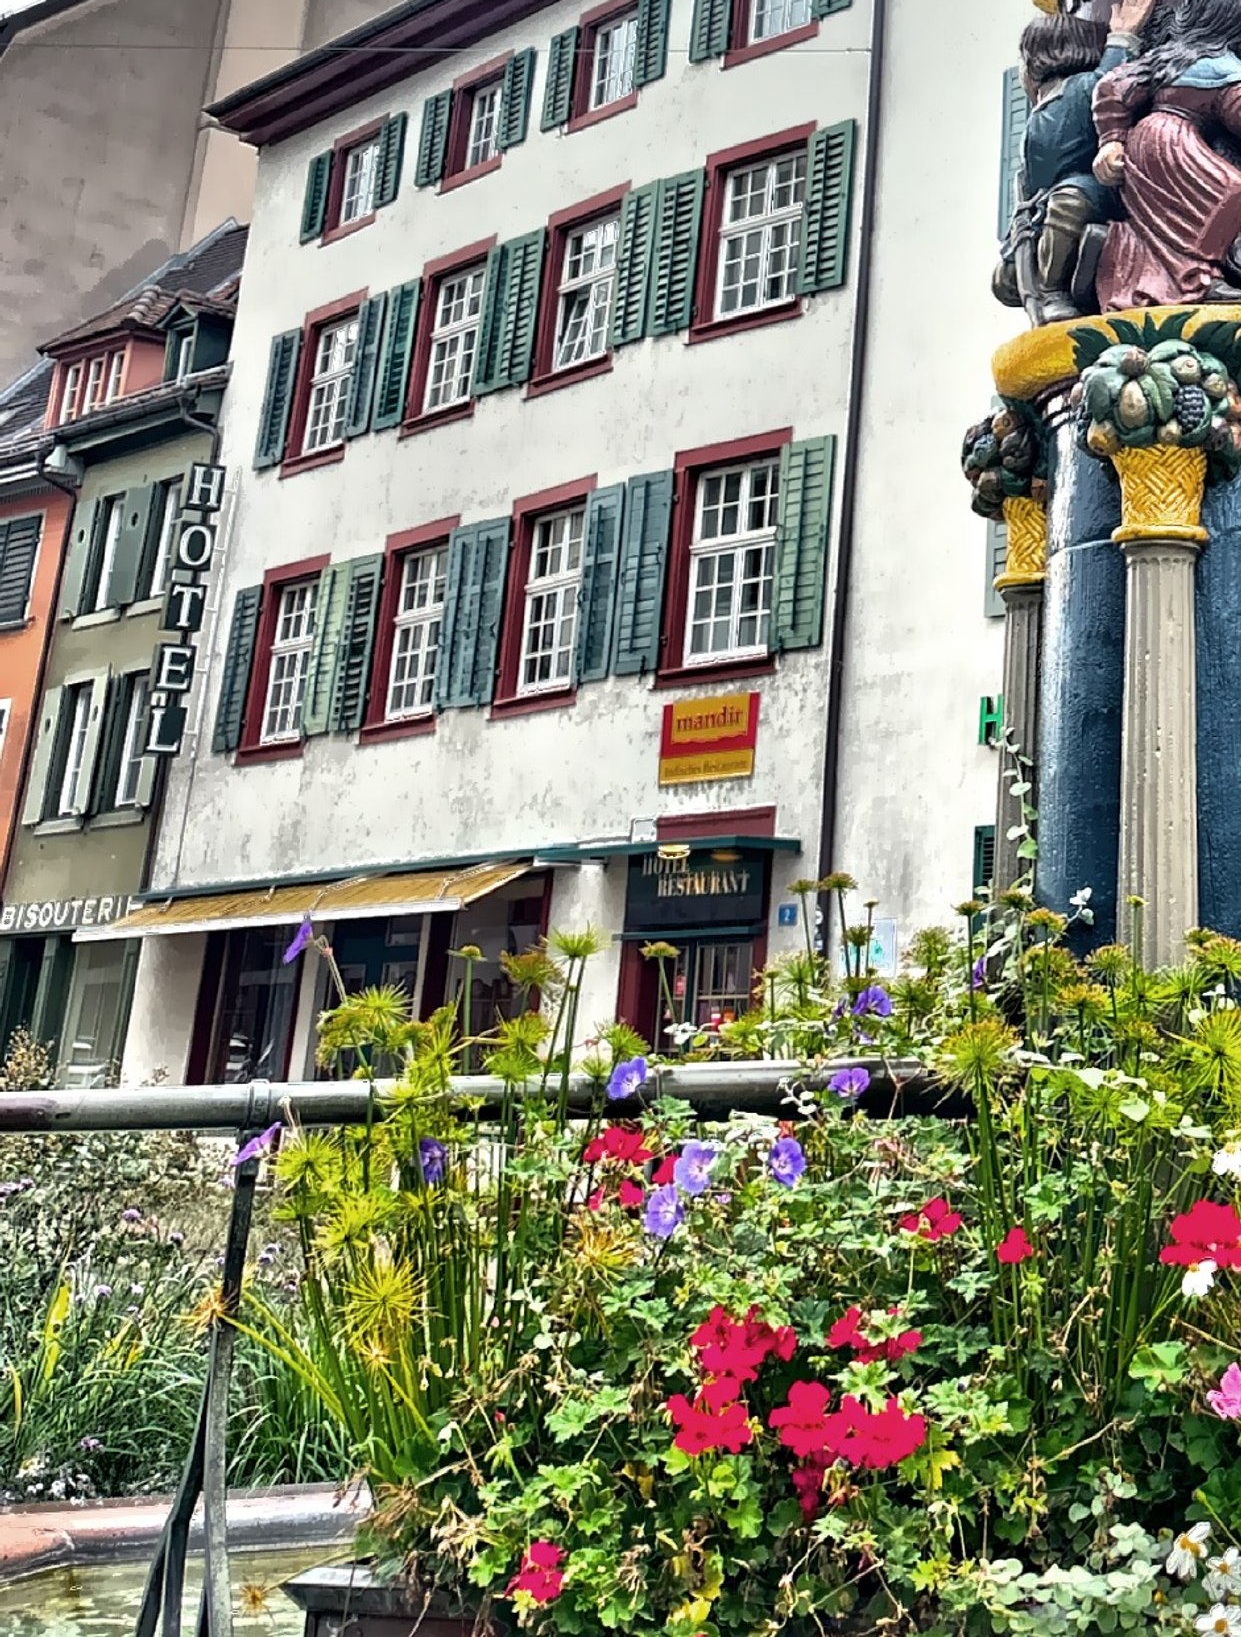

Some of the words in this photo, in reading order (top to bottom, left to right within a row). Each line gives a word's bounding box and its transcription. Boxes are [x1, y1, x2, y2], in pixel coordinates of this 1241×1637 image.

[147, 465, 225, 752] HOTEL
[676, 705, 743, 733] mandir
[657, 869, 750, 897] RESTAURANT
